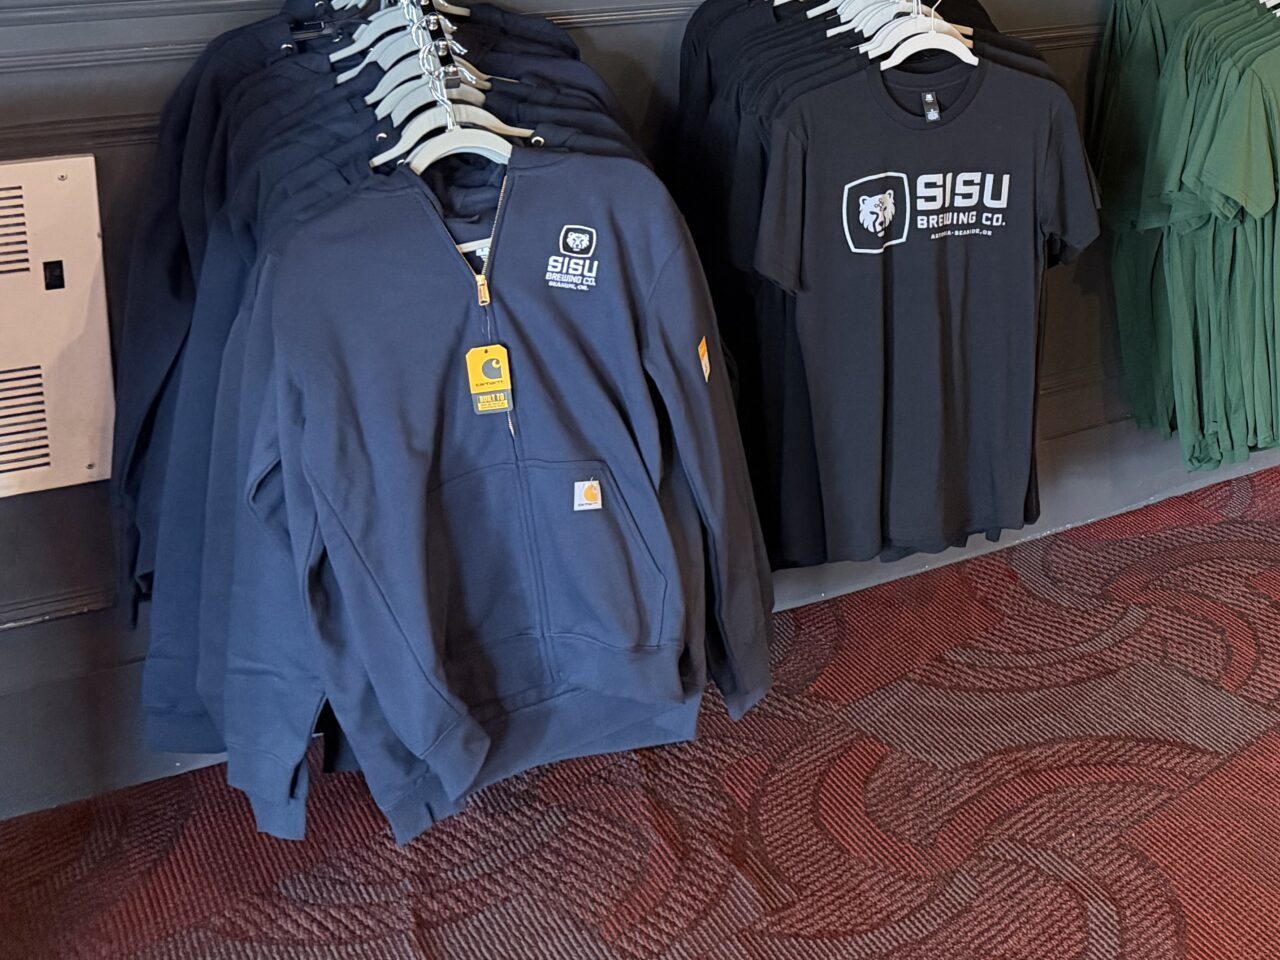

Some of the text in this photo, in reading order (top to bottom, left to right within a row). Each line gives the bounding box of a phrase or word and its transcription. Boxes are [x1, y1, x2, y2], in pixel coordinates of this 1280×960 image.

[916, 172, 1011, 211] SISU
[916, 211, 1006, 229] BREWING CO.
[547, 256, 599, 278] SISU
[545, 271, 597, 286] BREWING CO.
